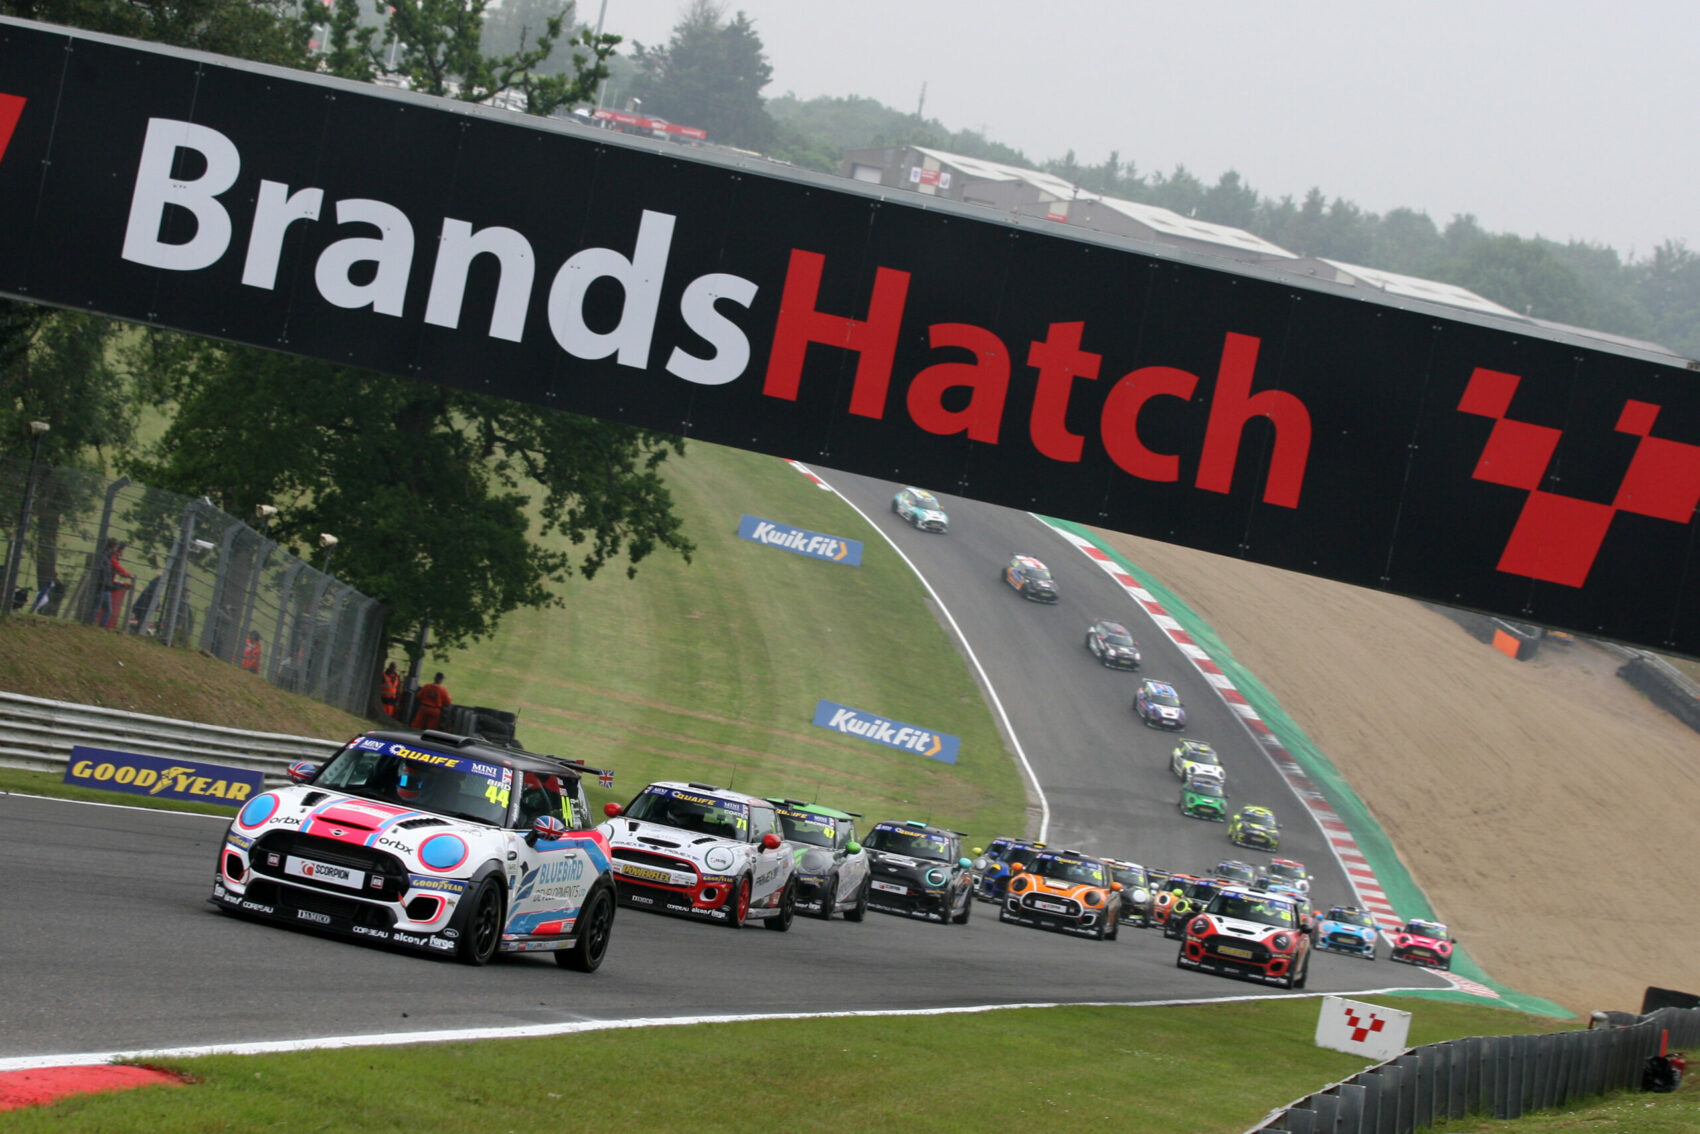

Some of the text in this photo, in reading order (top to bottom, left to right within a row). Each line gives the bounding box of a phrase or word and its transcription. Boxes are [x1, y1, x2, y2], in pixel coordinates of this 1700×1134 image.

[397, 748, 460, 768] QUAIFE
[472, 763, 497, 774] MINI
[487, 778, 511, 791] BIRD
[485, 786, 510, 809] 44
[269, 815, 303, 826] orbx
[735, 817, 748, 832] 71
[379, 837, 415, 856] orbx
[315, 863, 350, 881] SCORPION
